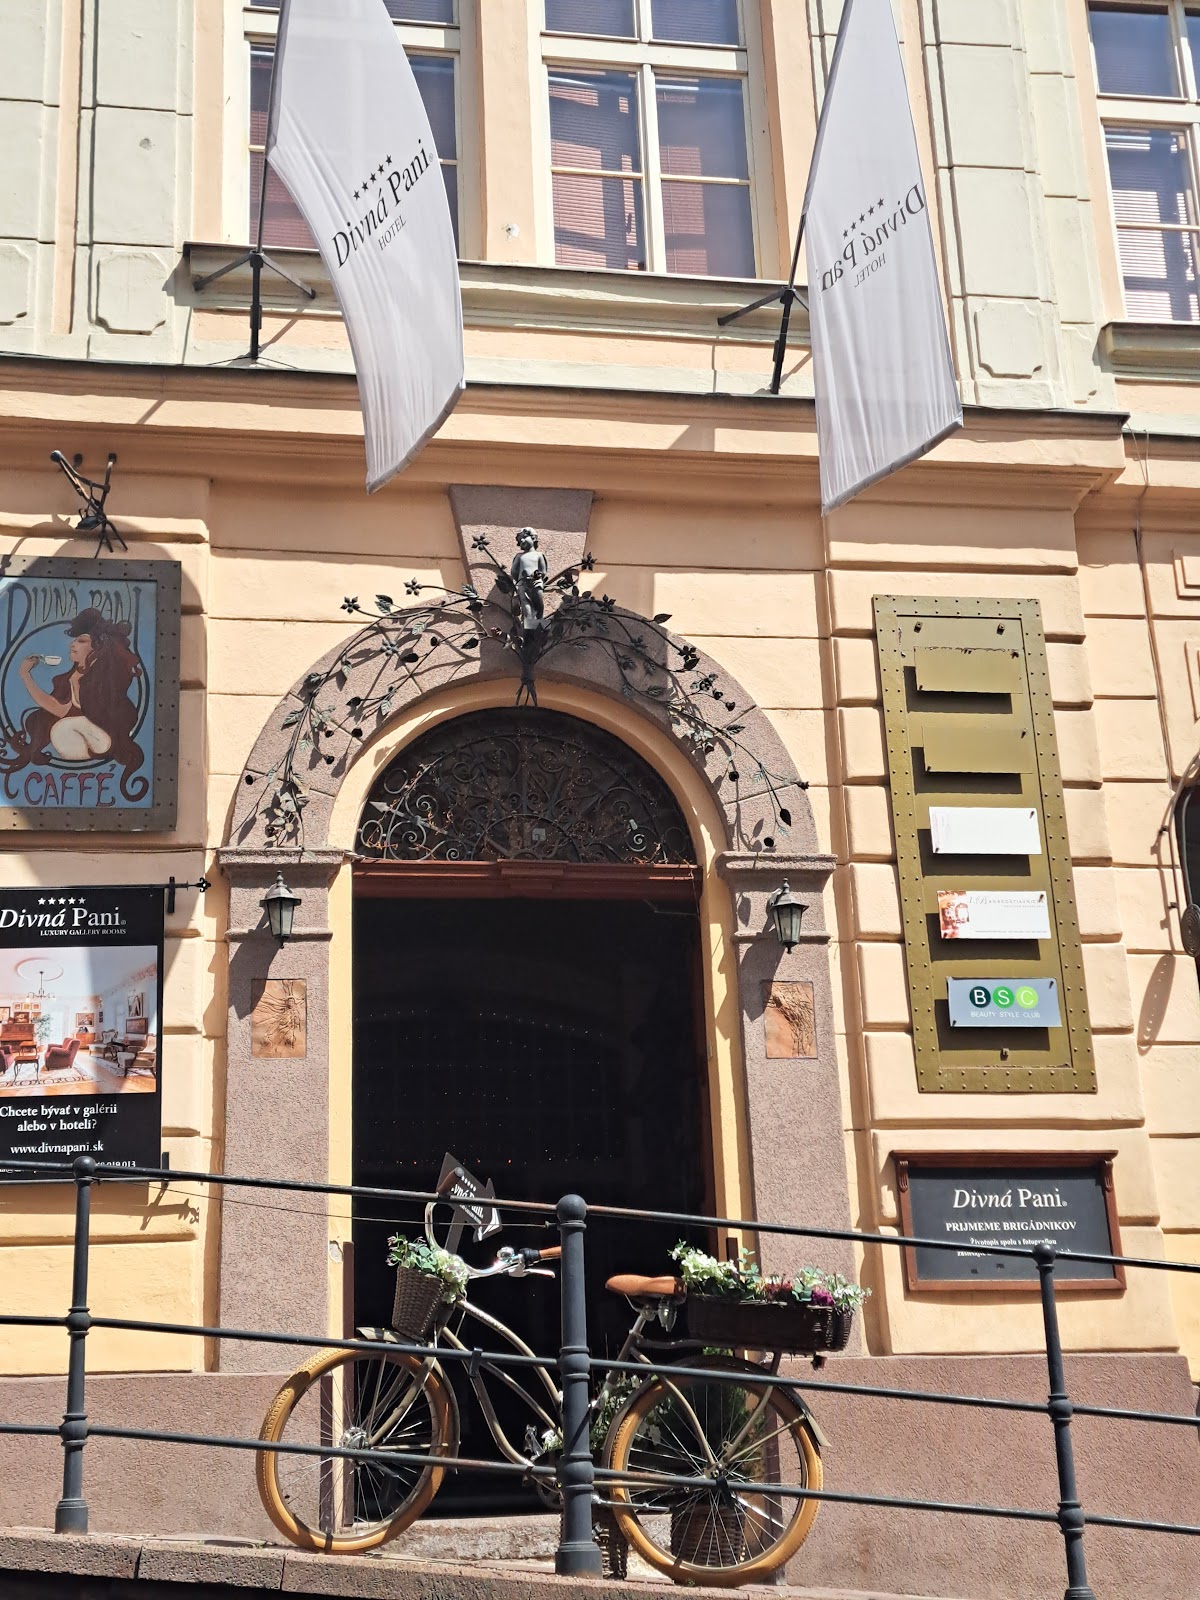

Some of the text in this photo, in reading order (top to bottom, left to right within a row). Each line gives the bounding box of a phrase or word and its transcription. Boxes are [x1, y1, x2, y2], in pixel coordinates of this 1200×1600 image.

[331, 187, 389, 268] Divná
[377, 214, 407, 251] HOTEL
[24, 764, 116, 807] CAFFÉ
[0, 907, 67, 928] Divná
[0, 1103, 118, 1118] Chcete bývať v galérii
[17, 1118, 97, 1132] alebo v hoteli?
[10, 1140, 104, 1156] www.divnapani.sk
[953, 1188, 1012, 1208] Divná
[945, 1219, 1077, 1231] PRIJMEME BRIGÁDNIKOV
